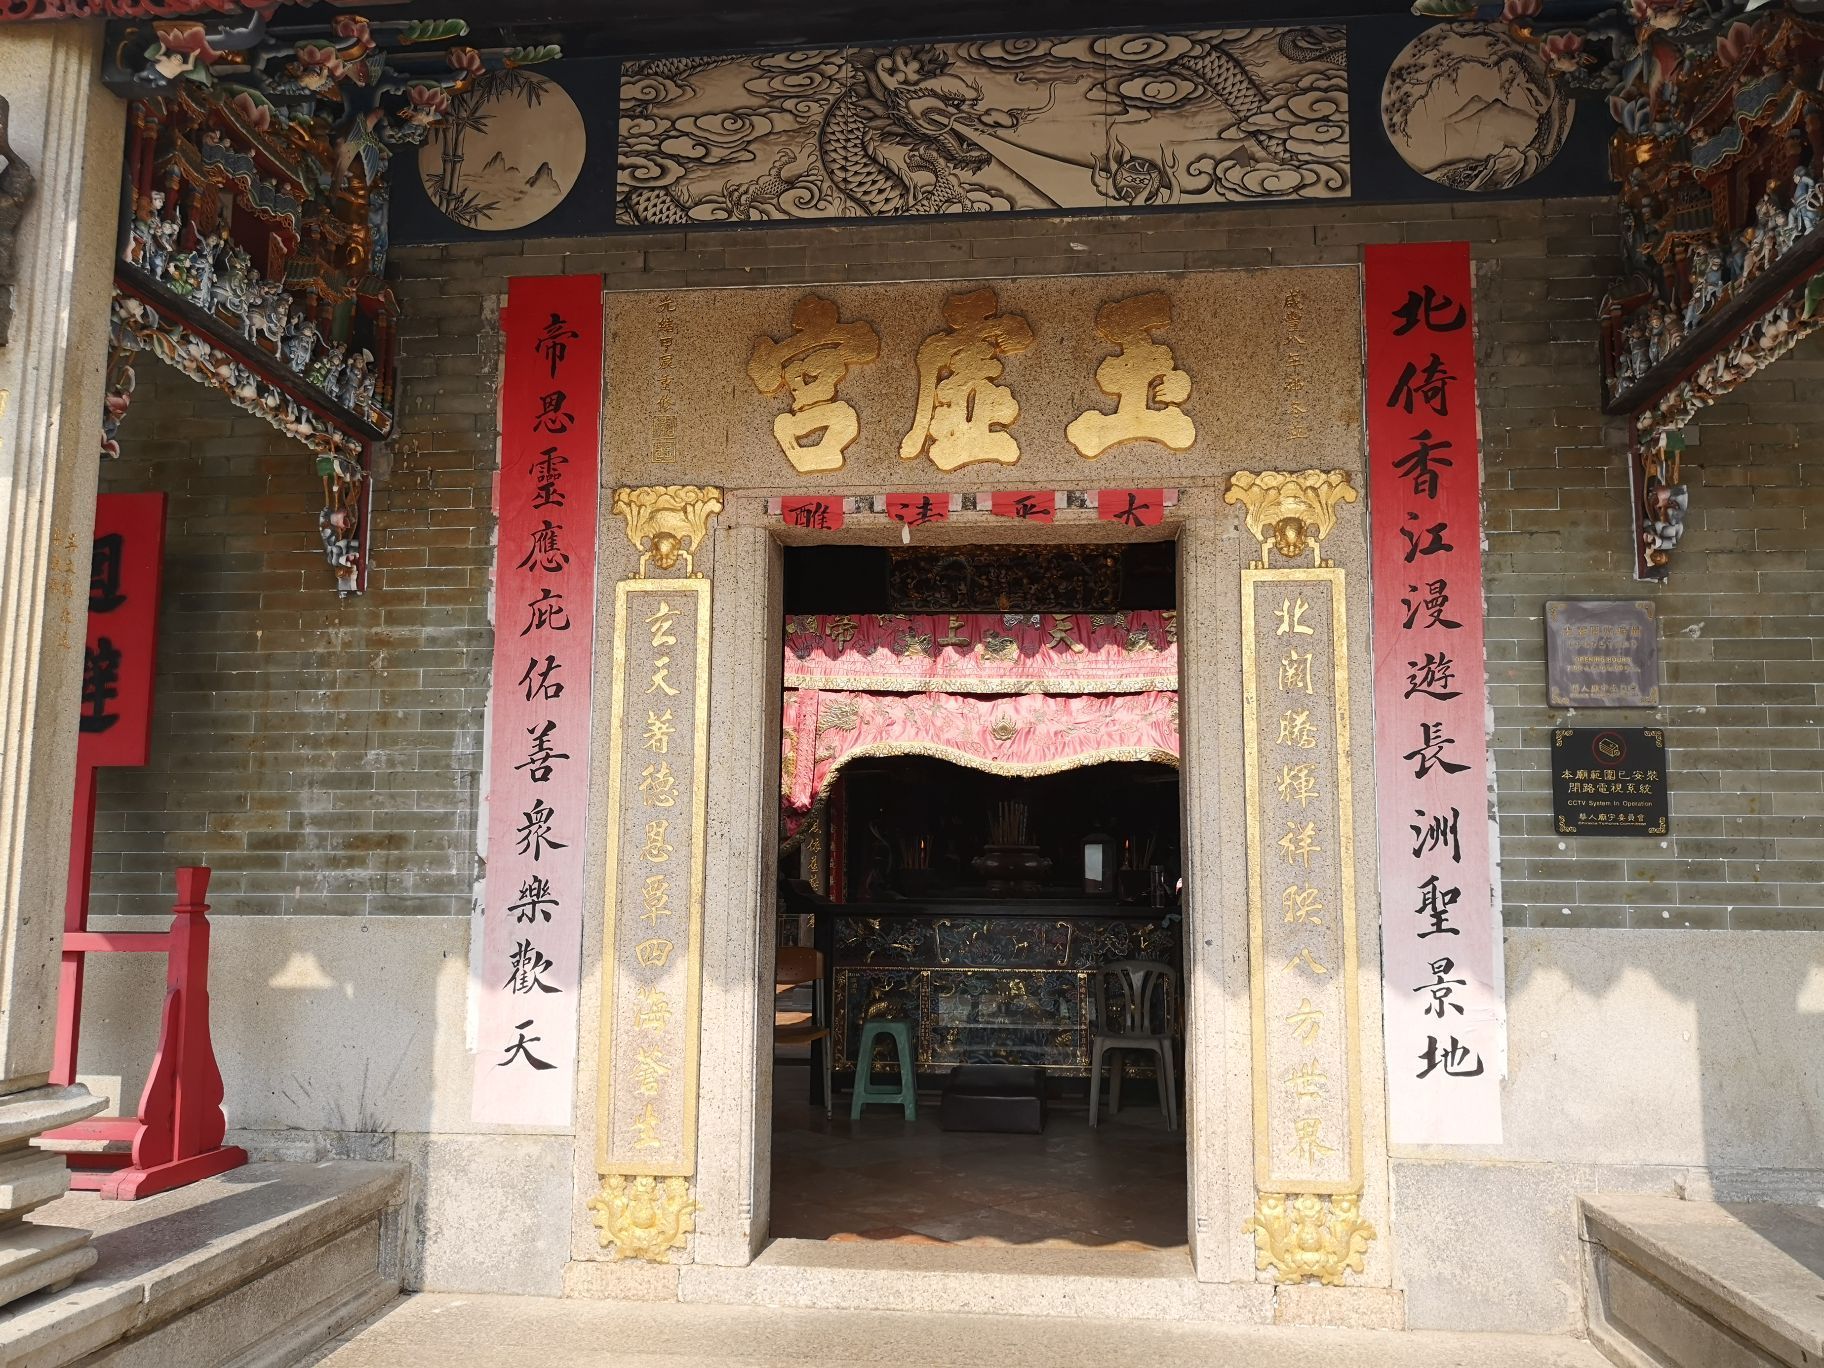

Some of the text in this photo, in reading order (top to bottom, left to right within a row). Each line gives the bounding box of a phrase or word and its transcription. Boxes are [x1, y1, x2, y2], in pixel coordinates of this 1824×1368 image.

[1387, 285, 1484, 1079] 北倚香江漫遊長洲聖景地
[1561, 769, 1659, 781] 本廟範圍已安裝
